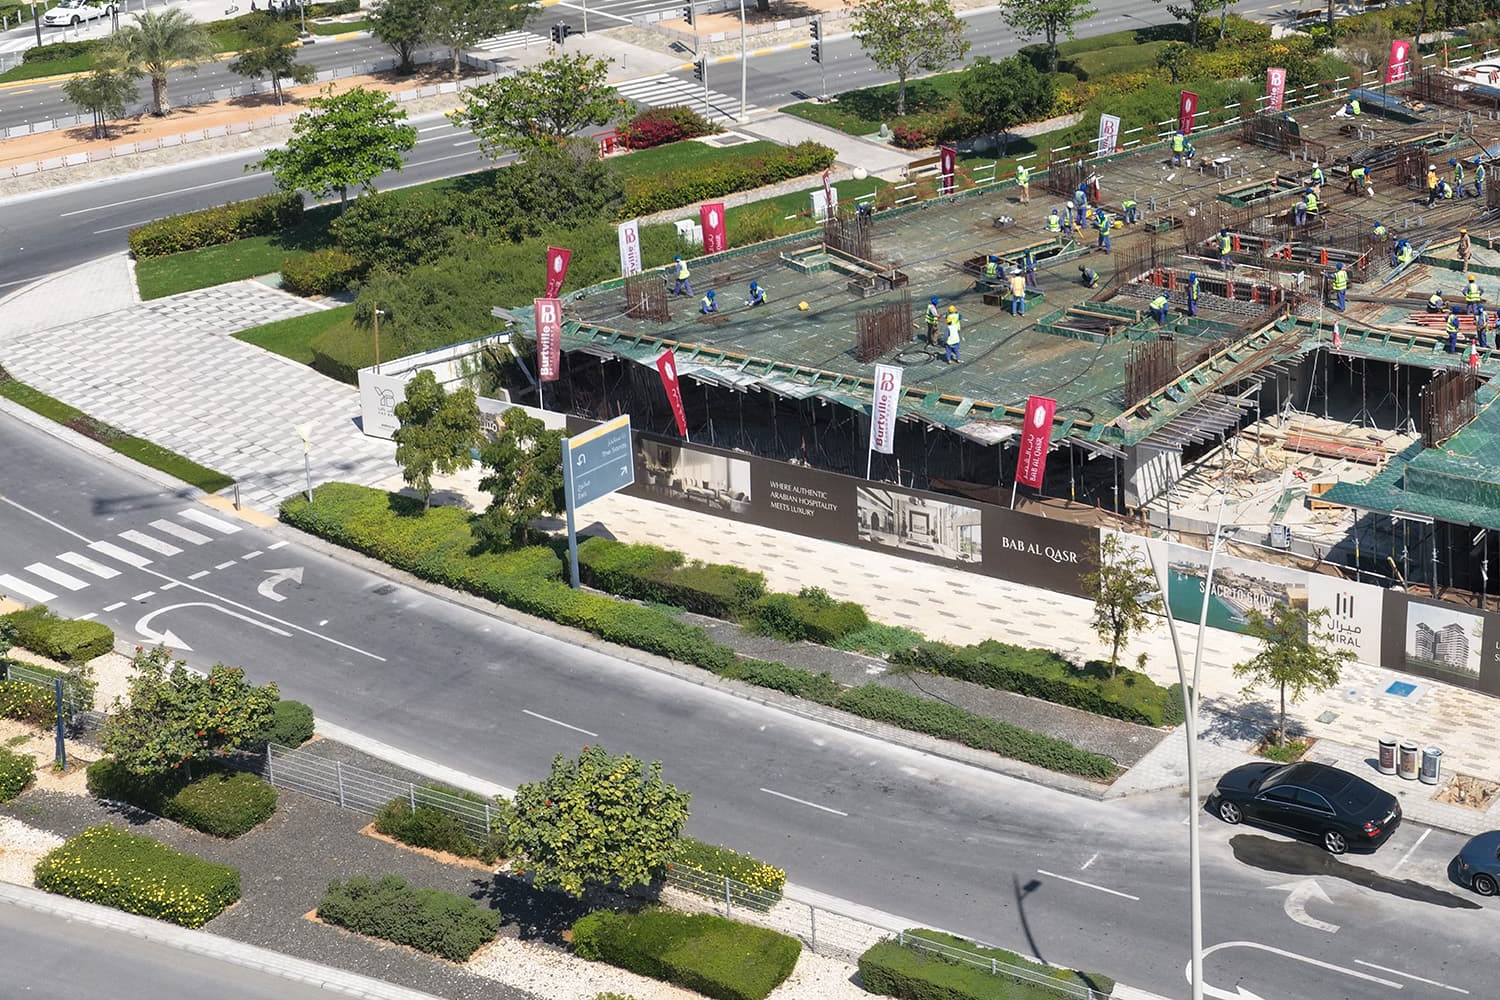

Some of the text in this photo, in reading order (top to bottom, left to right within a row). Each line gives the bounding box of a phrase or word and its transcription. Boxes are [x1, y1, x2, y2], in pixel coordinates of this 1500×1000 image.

[540, 325, 551, 376] Burtville
[875, 395, 888, 447] Burtville
[769, 480, 828, 499] WHERE AUTHENTIC
[770, 491, 838, 511] ARABIAN HOSPITALITY
[770, 501, 815, 516] MEETS LUXURY
[1002, 536, 1078, 564] BAB AL QASR
[1199, 581, 1232, 598] SACE
[1232, 588, 1243, 600] TO
[1327, 619, 1361, 635] ميرال
[1328, 632, 1361, 648] IRAL
